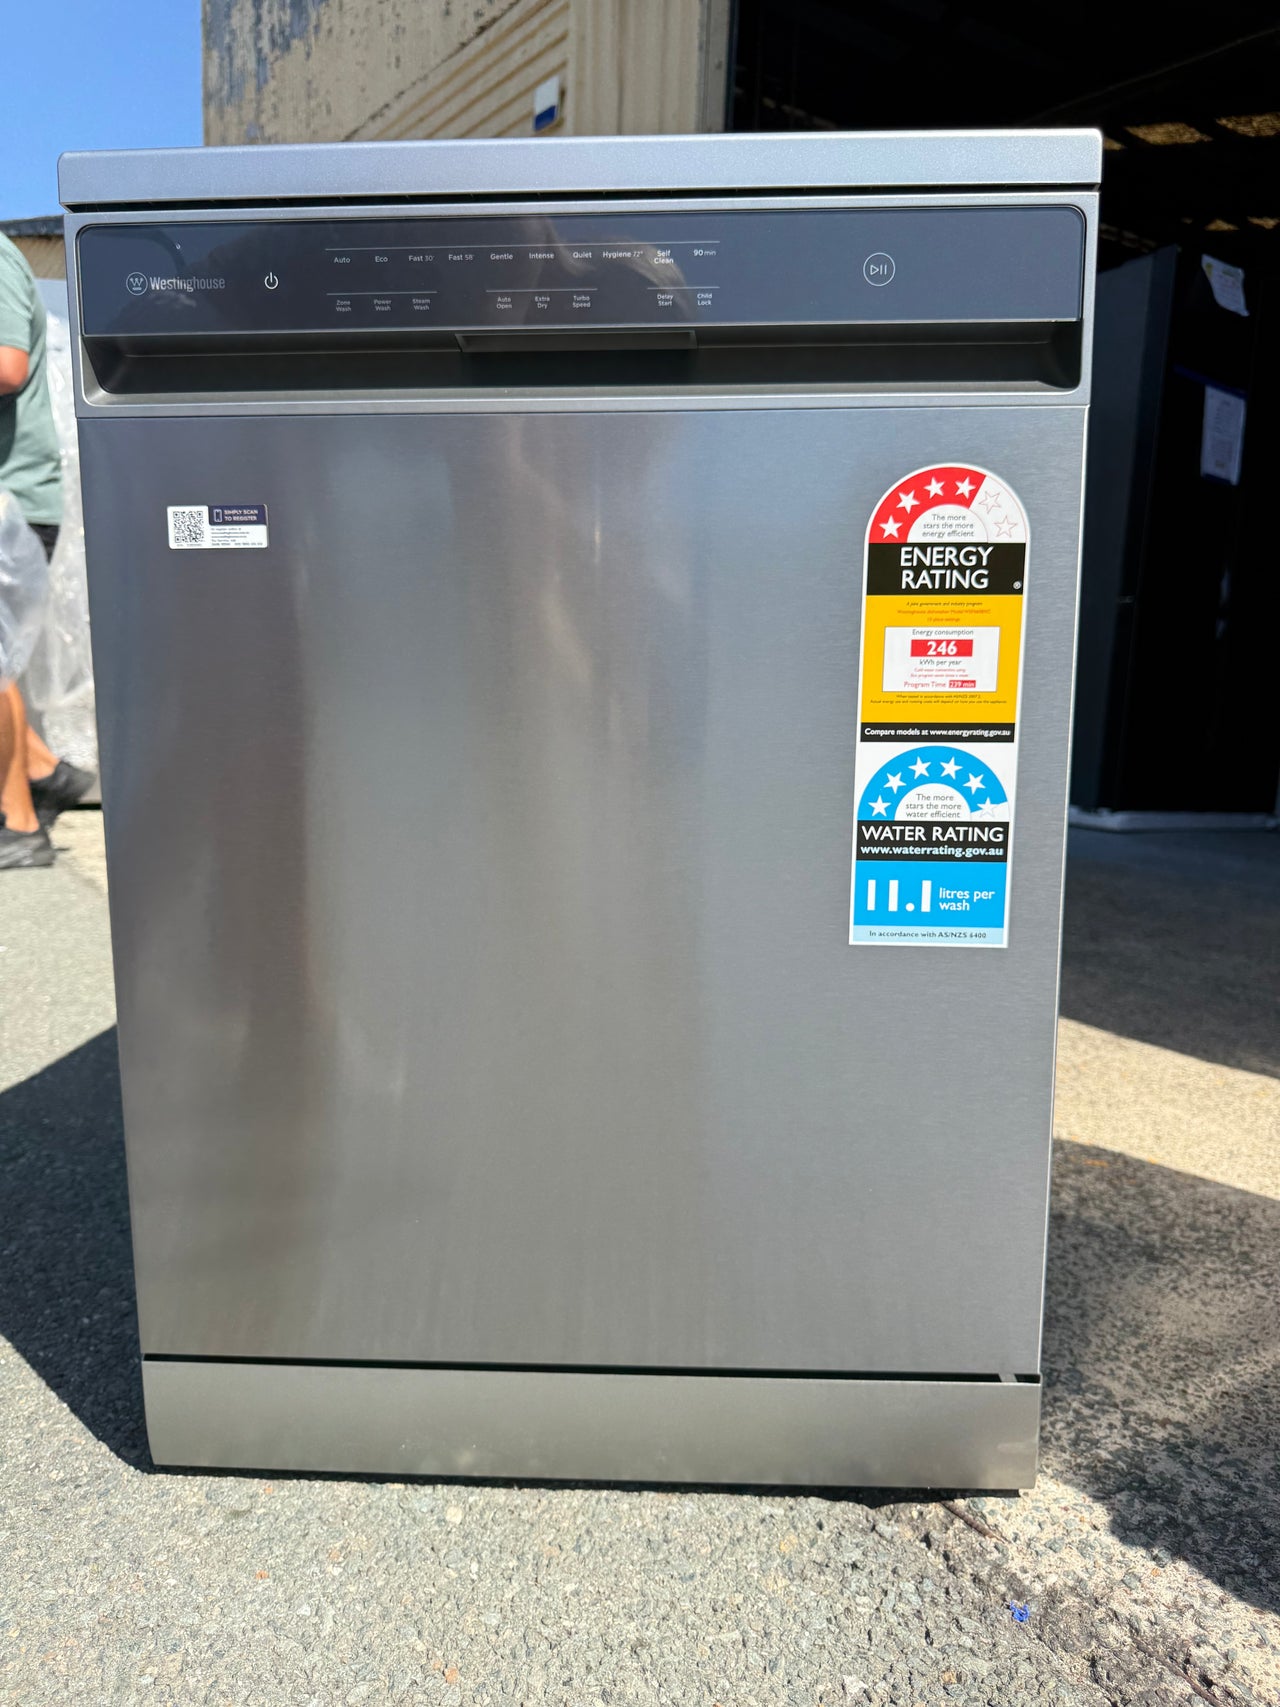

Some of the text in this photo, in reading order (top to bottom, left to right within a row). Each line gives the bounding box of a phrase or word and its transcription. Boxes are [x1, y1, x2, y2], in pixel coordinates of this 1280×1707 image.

[150, 276, 226, 292] Westinghouse
[900, 546, 994, 566] ENERGY
[902, 569, 989, 589] RATING
[927, 641, 957, 655] 246
[930, 729, 1011, 737] www.energyrating.gov.au
[862, 826, 1004, 842] WATER RATING
[861, 845, 1003, 857] www.waterrating.gov.au
[867, 879, 932, 912] 11.1
[939, 887, 995, 902] litres per
[939, 900, 970, 911] wash
